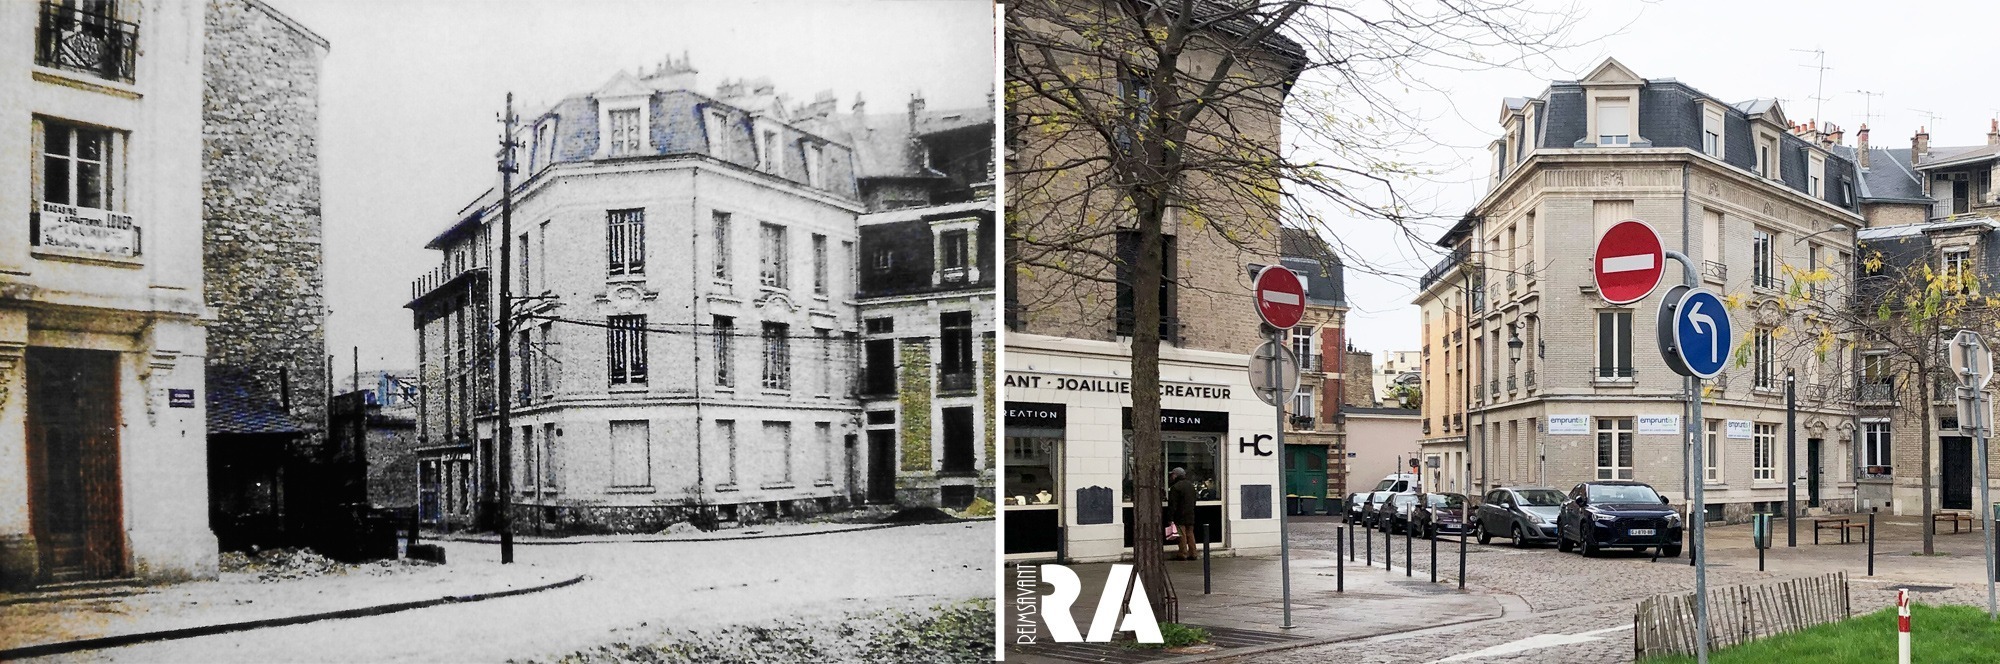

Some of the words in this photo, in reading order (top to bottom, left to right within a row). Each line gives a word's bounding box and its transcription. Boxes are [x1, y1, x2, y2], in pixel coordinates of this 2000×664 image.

[107, 213, 132, 230] LOUER
[1057, 378, 1130, 393] JOAILLIE
[1161, 416, 1200, 424] RTISAN
